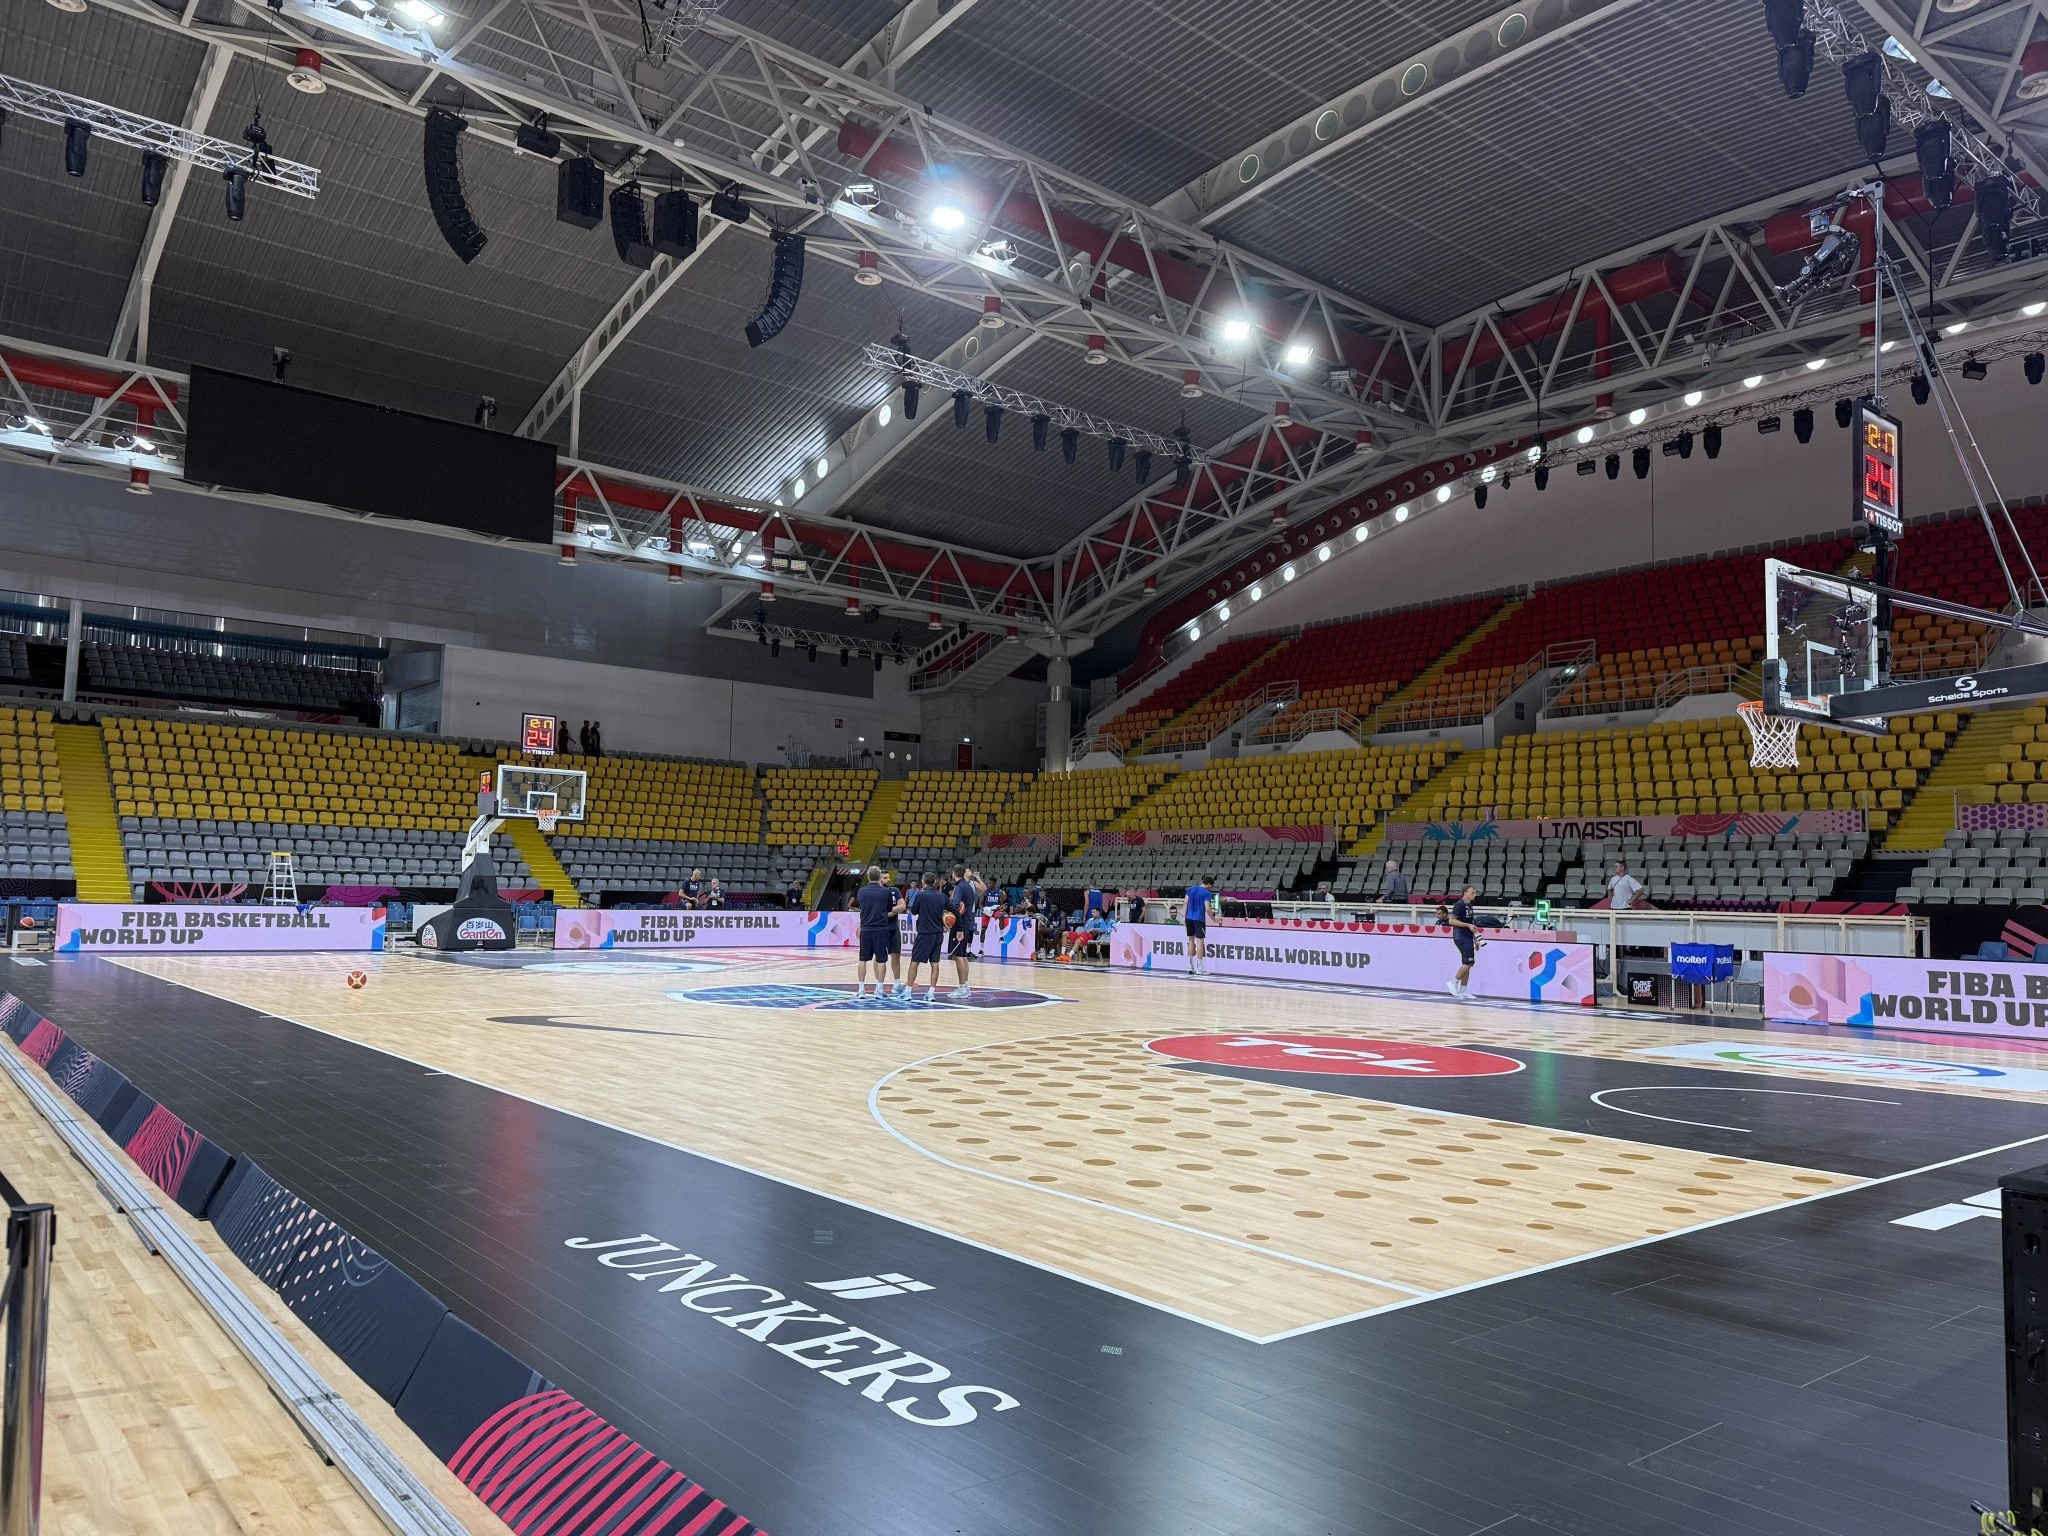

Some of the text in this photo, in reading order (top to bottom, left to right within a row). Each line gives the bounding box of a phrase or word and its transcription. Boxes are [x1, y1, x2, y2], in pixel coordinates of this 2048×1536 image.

[1866, 455, 1894, 506] 24
[1875, 511, 1903, 535] TISSOT
[1972, 687, 2008, 698] Sports
[527, 730, 551, 746] 24
[1539, 820, 1653, 840] LIMASSOL
[1163, 833, 1244, 845] MAKE YOUR MARK
[121, 911, 330, 928] FIBA BASKETBALL
[466, 920, 493, 929] 百岁山
[640, 915, 780, 929] FIBA BASKETBALL
[80, 928, 204, 945] WORLD UP
[613, 929, 695, 943] WORLD UP
[1152, 940, 1184, 956] FIBA
[1285, 949, 1343, 967] WORLD
[1345, 952, 1371, 969] UP
[1676, 955, 1708, 964] molten
[1927, 970, 2015, 998] FIBA
[1871, 993, 1998, 1024] WORLD
[1216, 1037, 1440, 1073] TCL
[564, 1233, 1021, 1427] JUNCKERS
